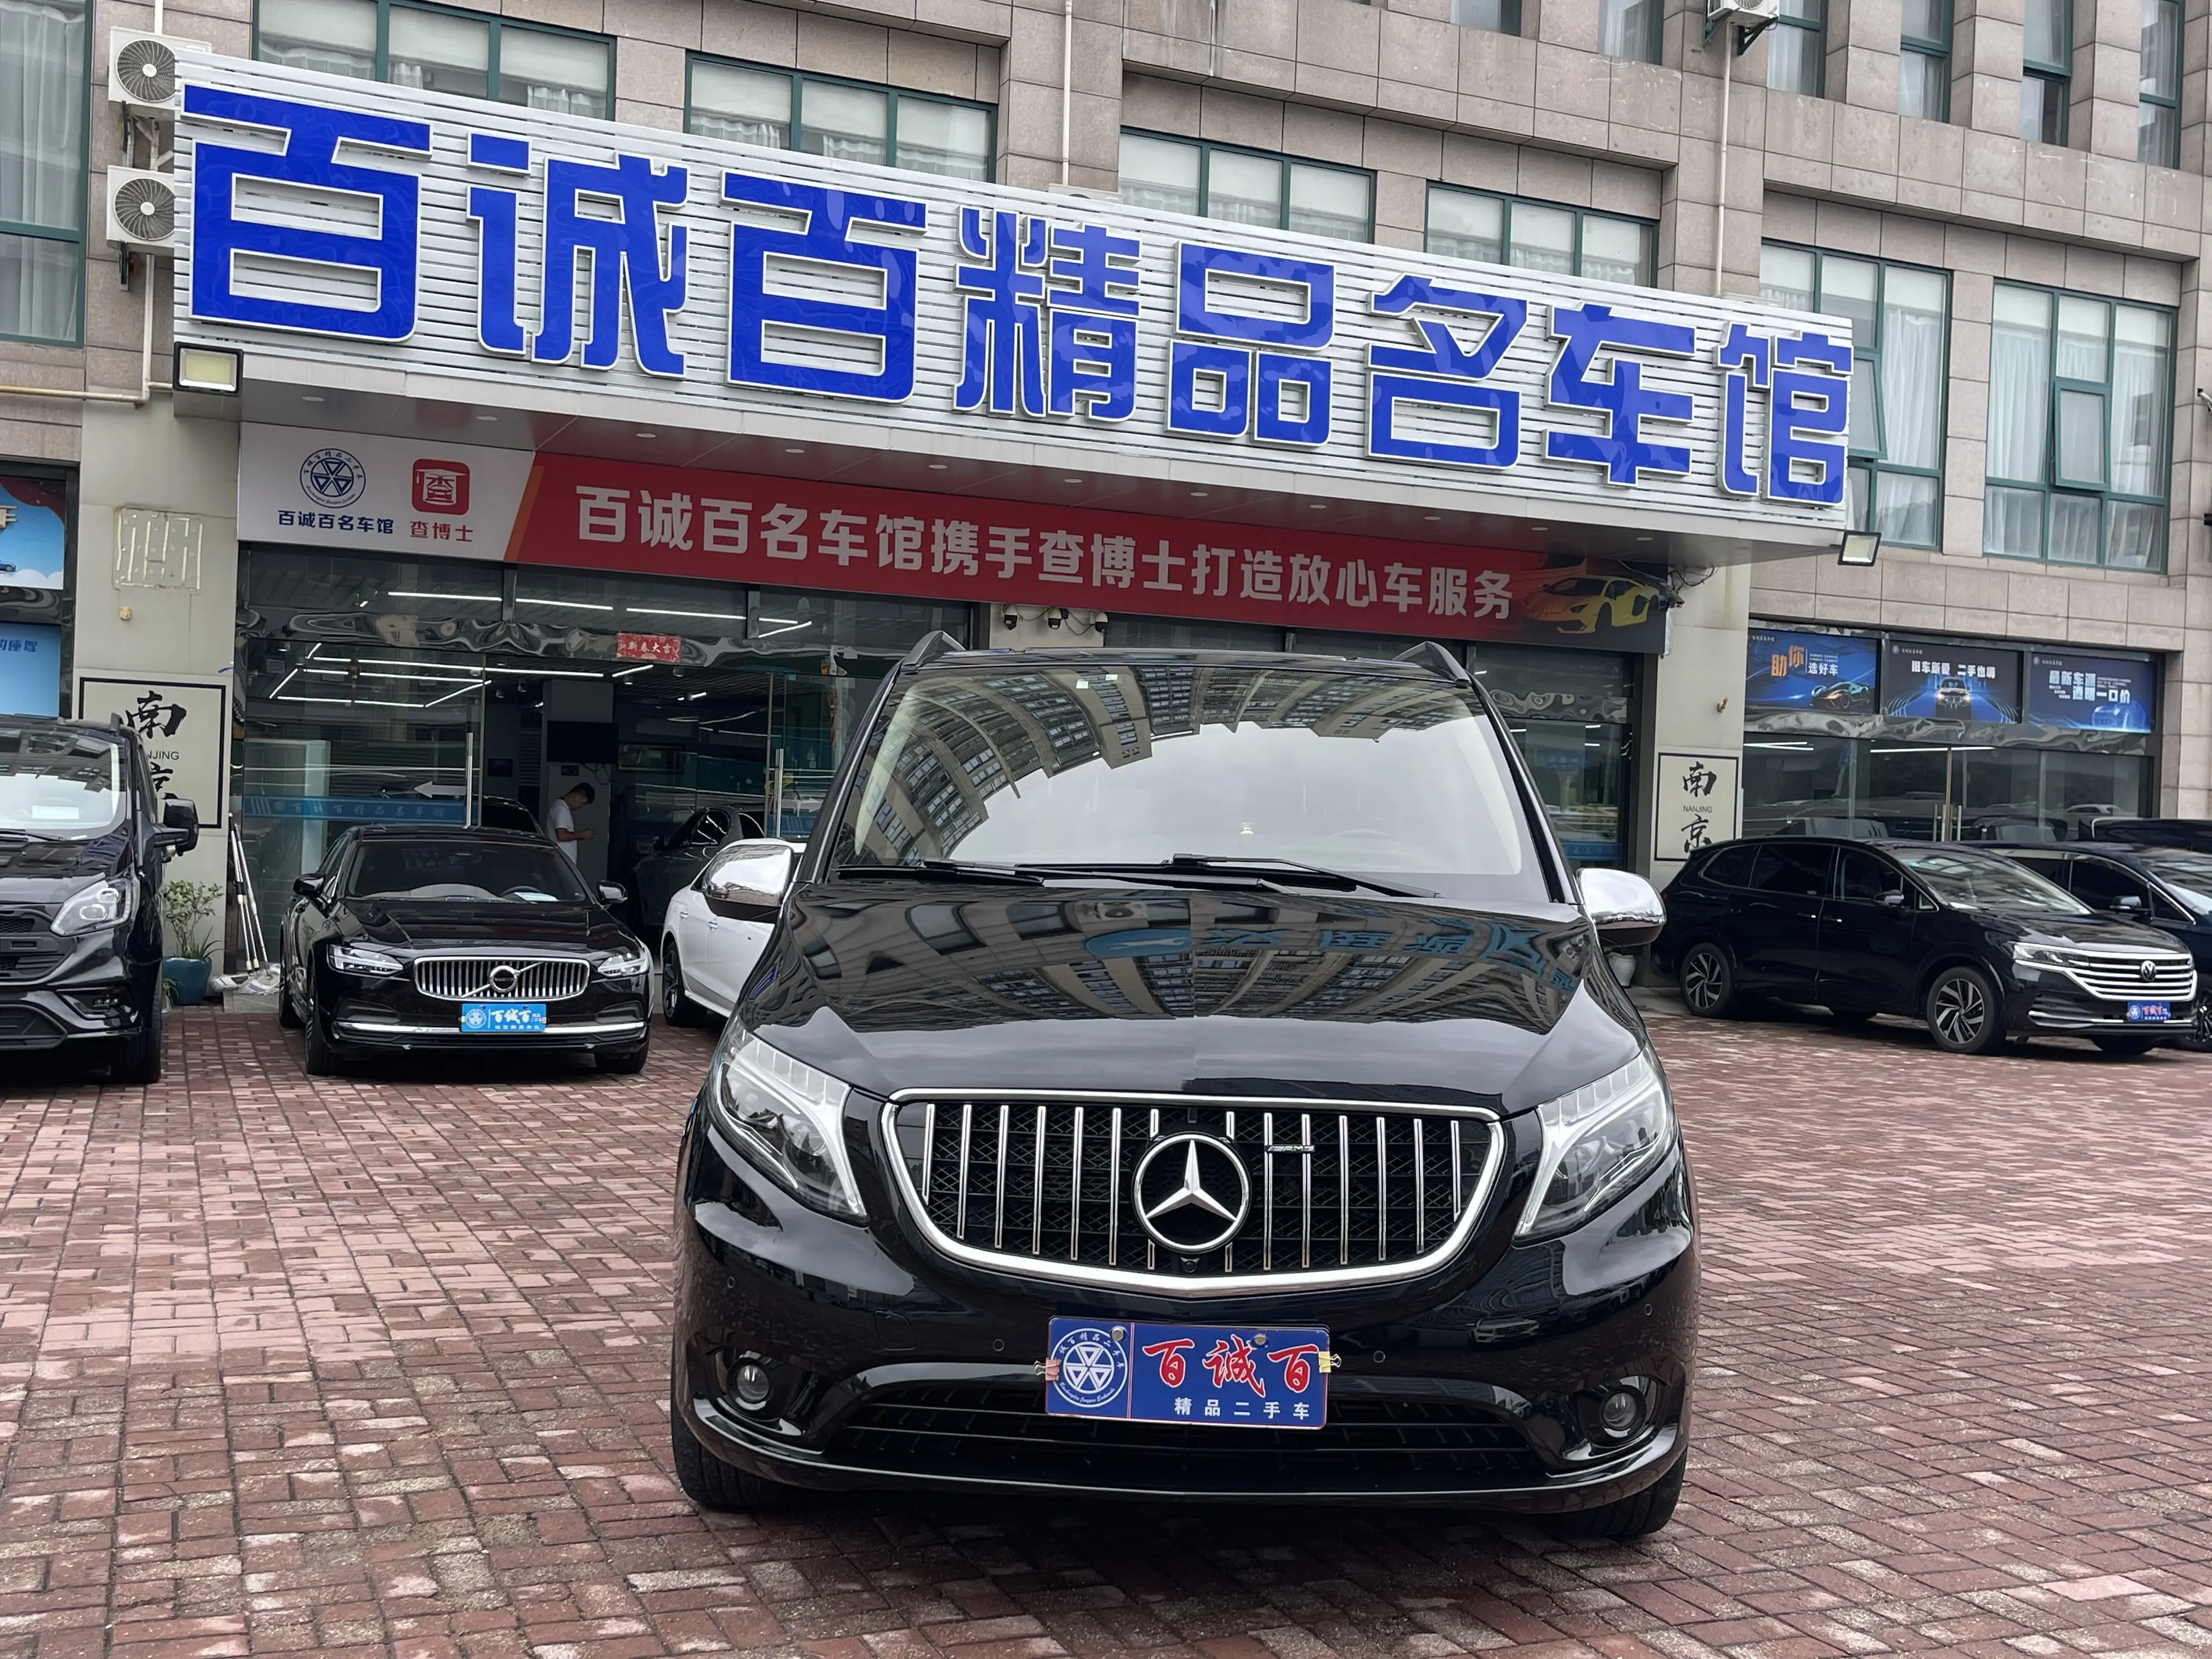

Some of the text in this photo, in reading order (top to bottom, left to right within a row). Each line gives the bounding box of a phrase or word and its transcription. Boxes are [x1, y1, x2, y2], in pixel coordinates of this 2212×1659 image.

[180, 82, 1853, 506] 百诚百精品名车馆
[278, 510, 394, 534] 百诚百名车馆
[410, 521, 473, 542] 查博士
[576, 485, 1513, 620] 百诚百名车馆携手查博士打造放心车服务
[1808, 662, 1838, 676] 选好车
[148, 751, 179, 760] NJING
[1683, 805, 1713, 813] NANJING
[1173, 1397, 1310, 1420] 精品二手车
